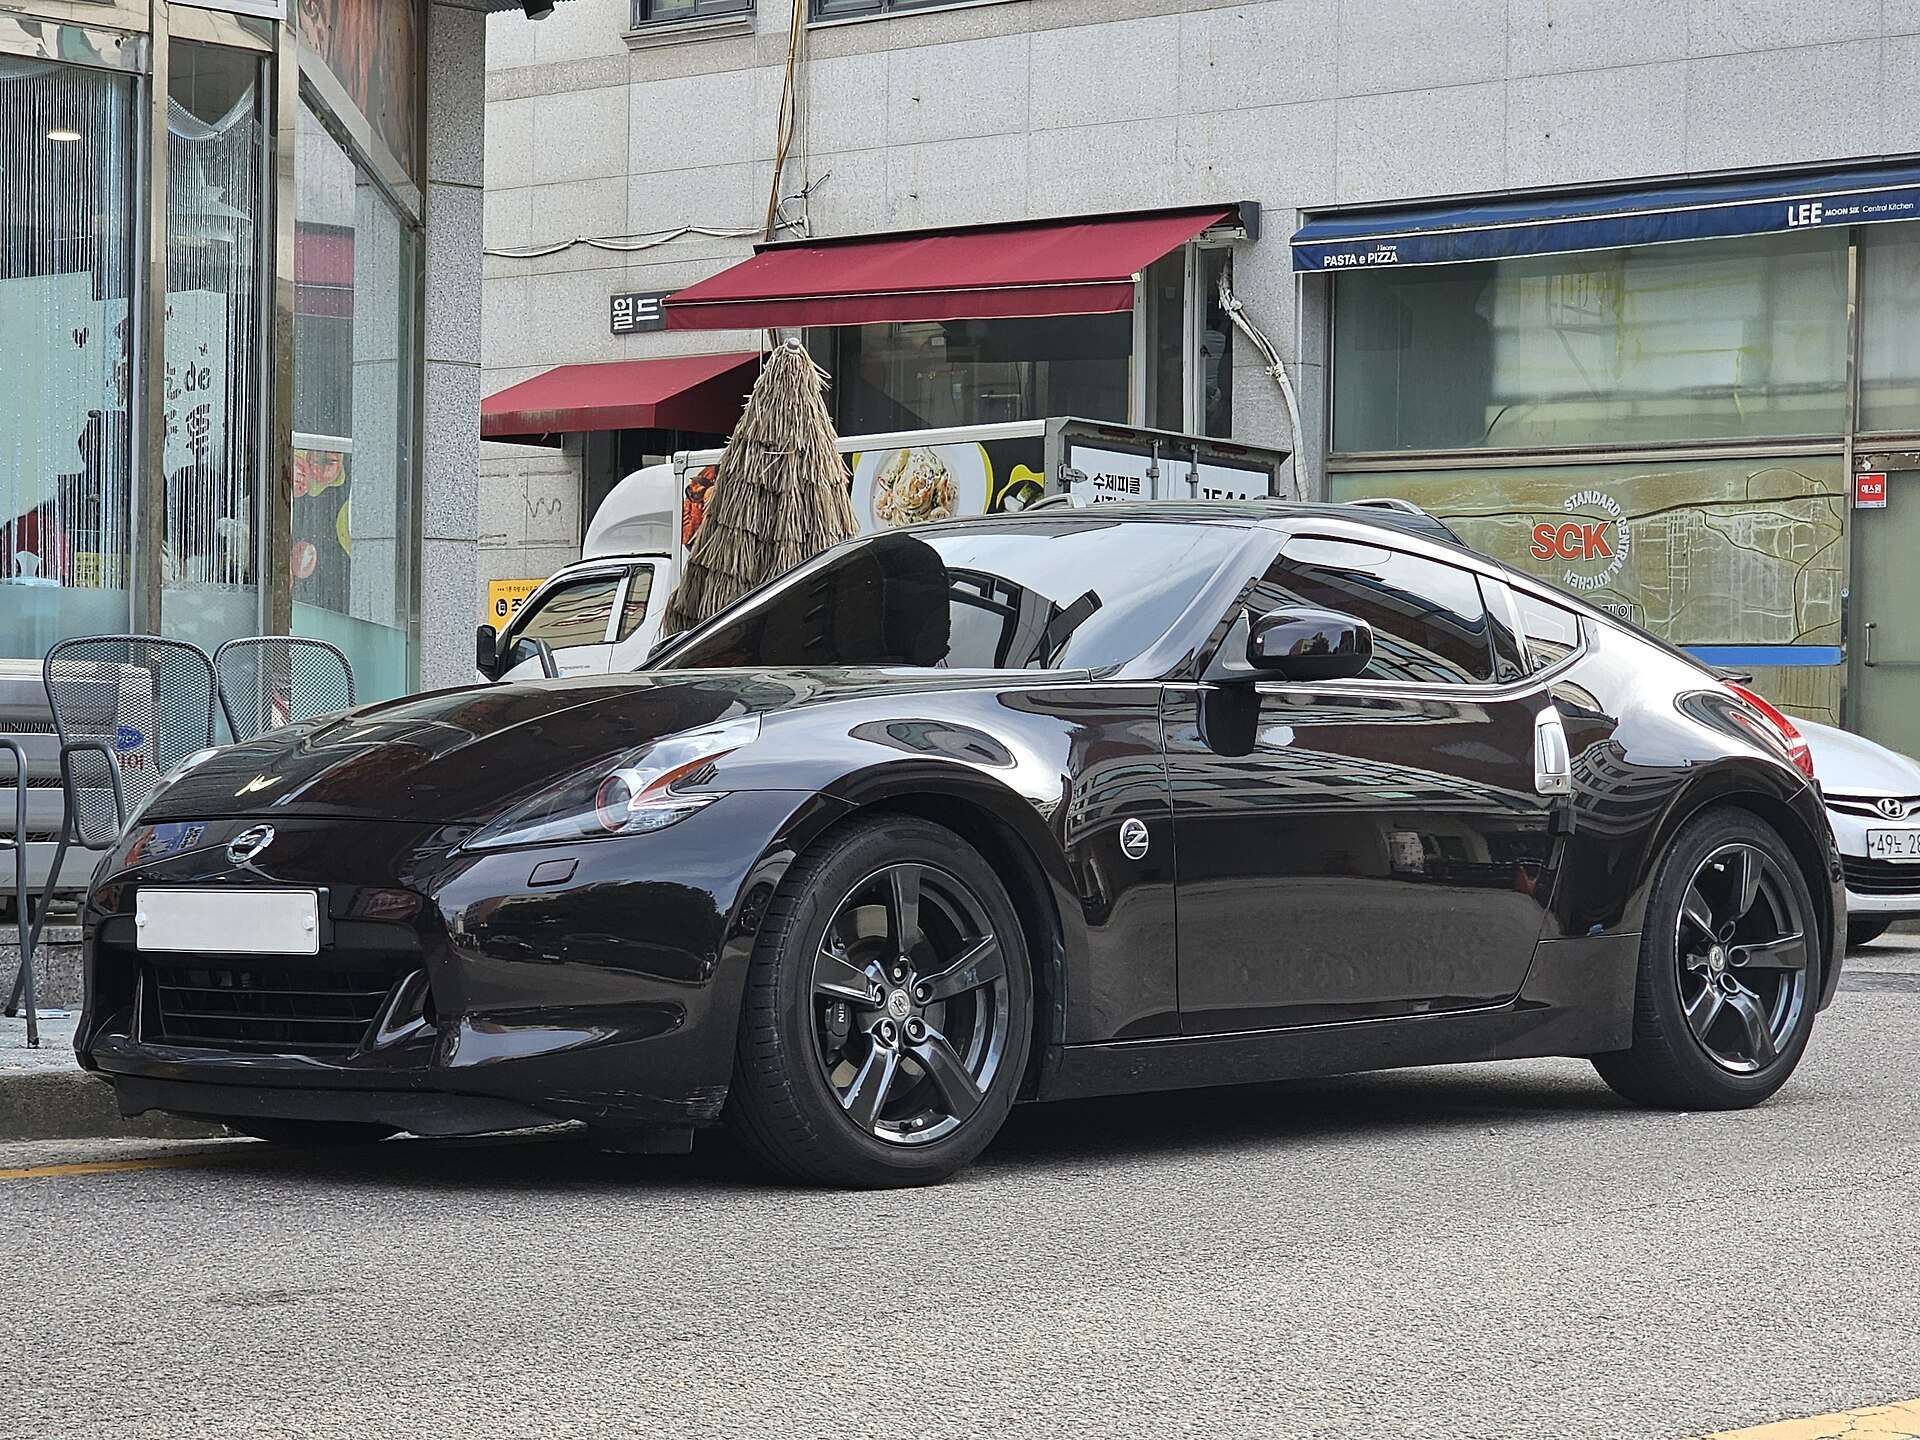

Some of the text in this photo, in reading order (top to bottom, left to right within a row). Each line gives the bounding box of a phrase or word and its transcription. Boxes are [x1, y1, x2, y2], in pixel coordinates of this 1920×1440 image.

[1788, 203, 1822, 226] LEE
[1825, 209, 1848, 217] MOON
[1863, 204, 1887, 212] Central
[1889, 202, 1914, 211] Kitchen
[1324, 251, 1398, 267] PASTA e PIZZA
[613, 297, 660, 330] 월드
[1093, 472, 1141, 495] 수제피클
[1564, 490, 1621, 517] STANDARD
[1529, 520, 1615, 561] SCK
[1608, 516, 1630, 575] CENTRAL
[1563, 569, 1611, 590] KITCHEN
[1877, 834, 1903, 854] 49노
